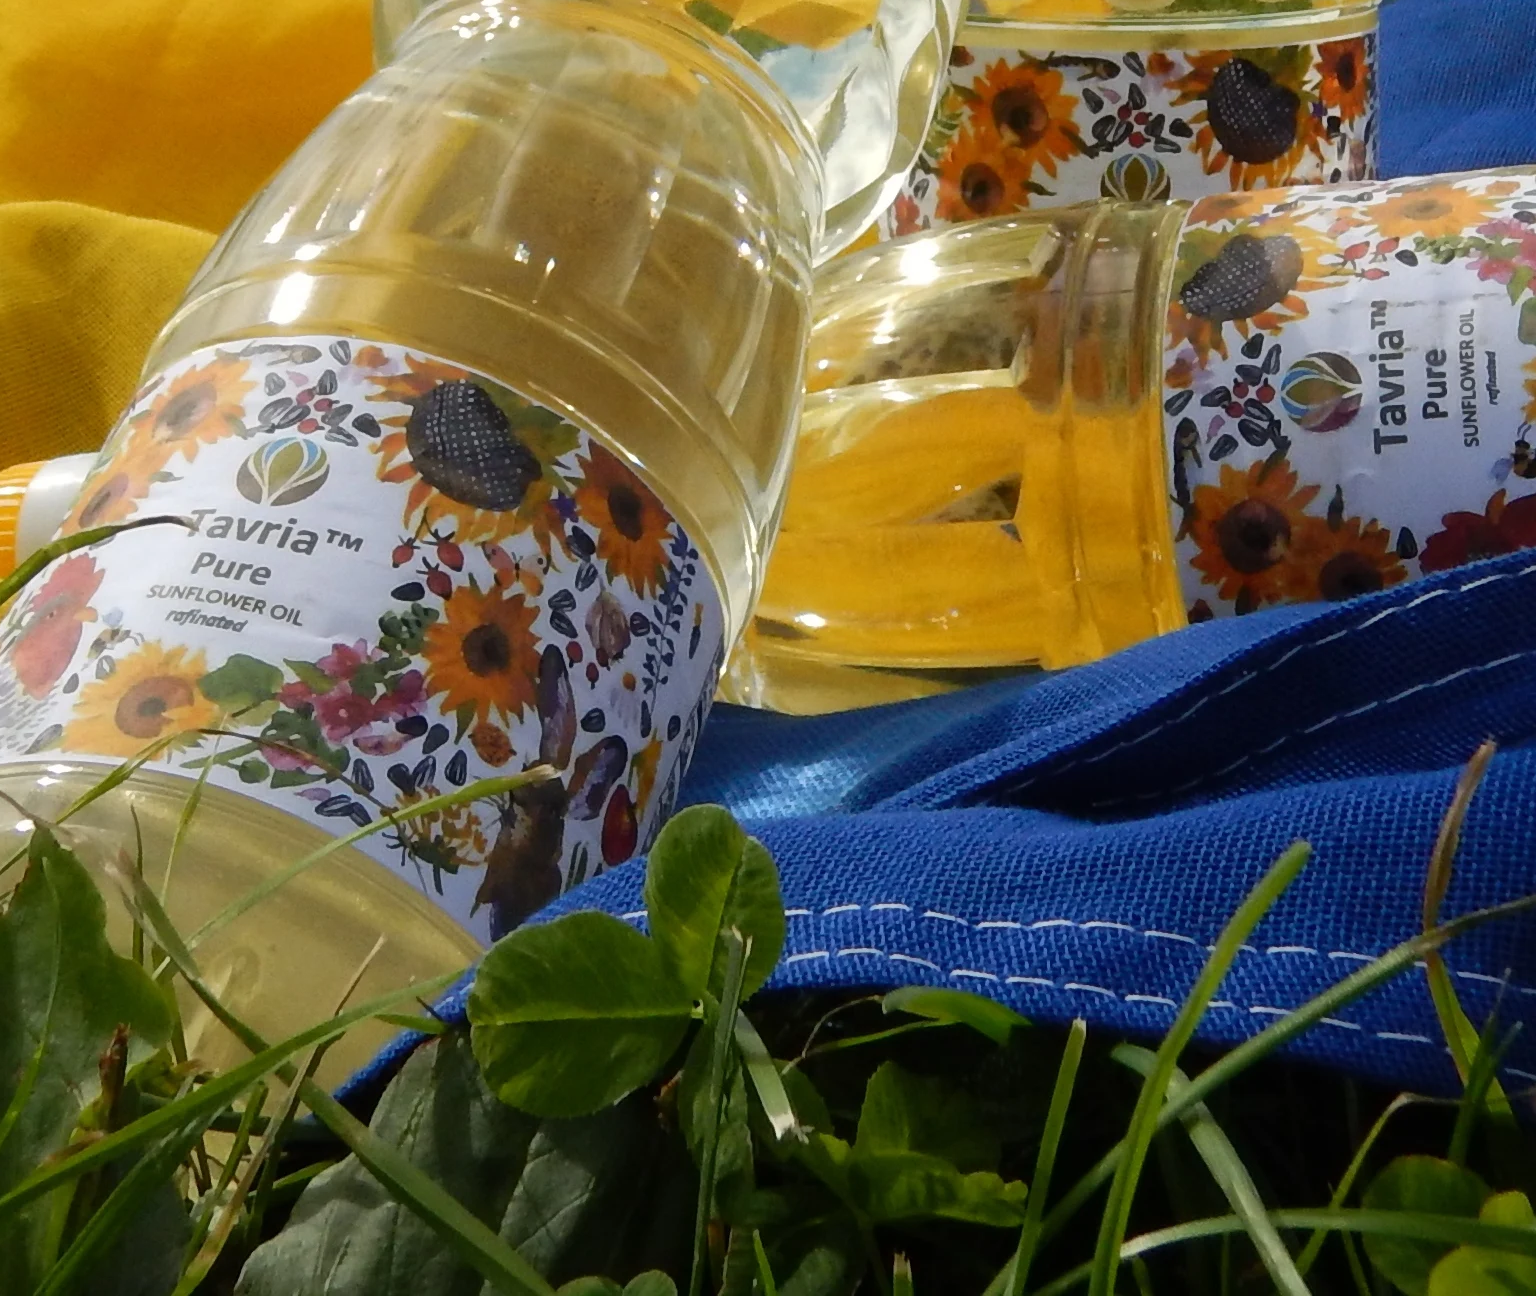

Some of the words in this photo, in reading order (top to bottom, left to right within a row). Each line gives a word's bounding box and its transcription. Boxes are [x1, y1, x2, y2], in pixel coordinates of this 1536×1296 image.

[1459, 308, 1476, 336] OIL
[1422, 348, 1449, 420] Pure
[1459, 339, 1480, 448] SUNFLOWER
[191, 552, 272, 586] Pure
[146, 584, 267, 615] SUNFLOWER
[269, 604, 304, 627] OIL
